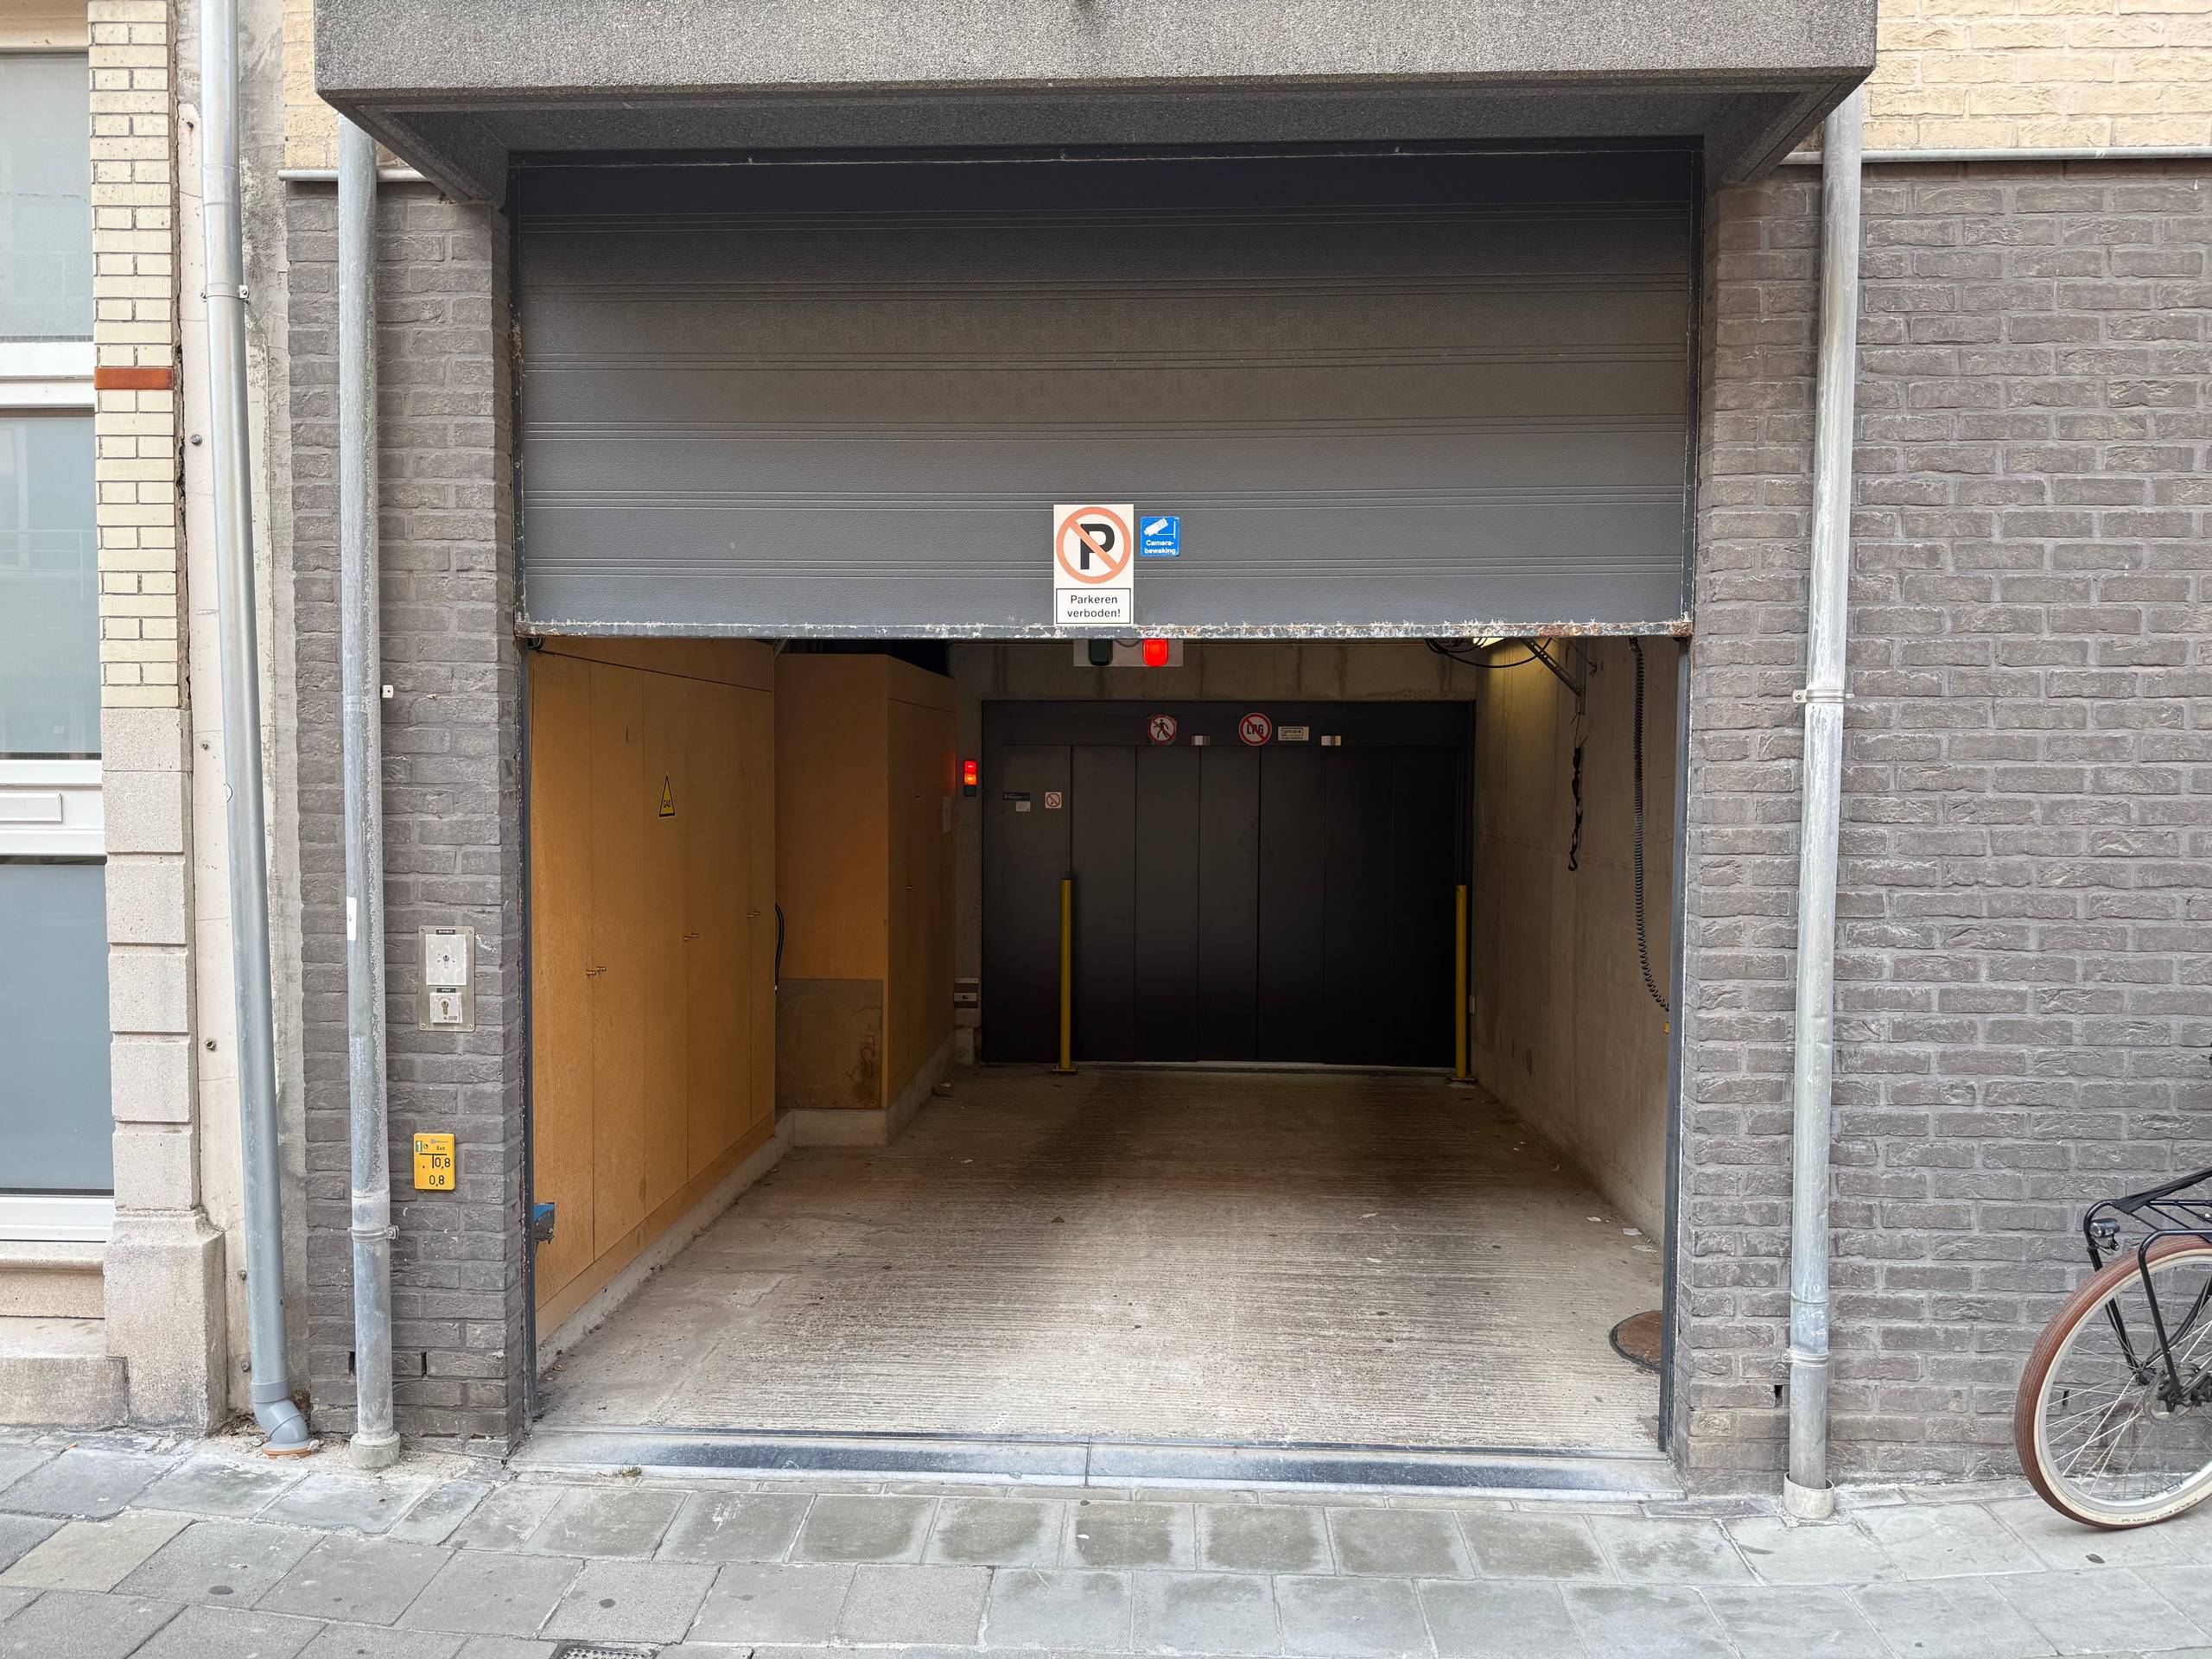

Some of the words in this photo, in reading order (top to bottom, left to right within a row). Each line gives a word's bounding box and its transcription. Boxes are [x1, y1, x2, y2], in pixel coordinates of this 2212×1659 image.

[1080, 524, 1115, 569] P
[1071, 595, 1118, 604] Parkeren
[1067, 608, 1121, 618] verboden!
[435, 1157, 451, 1169] 0,8
[429, 1175, 445, 1187] 0,8
